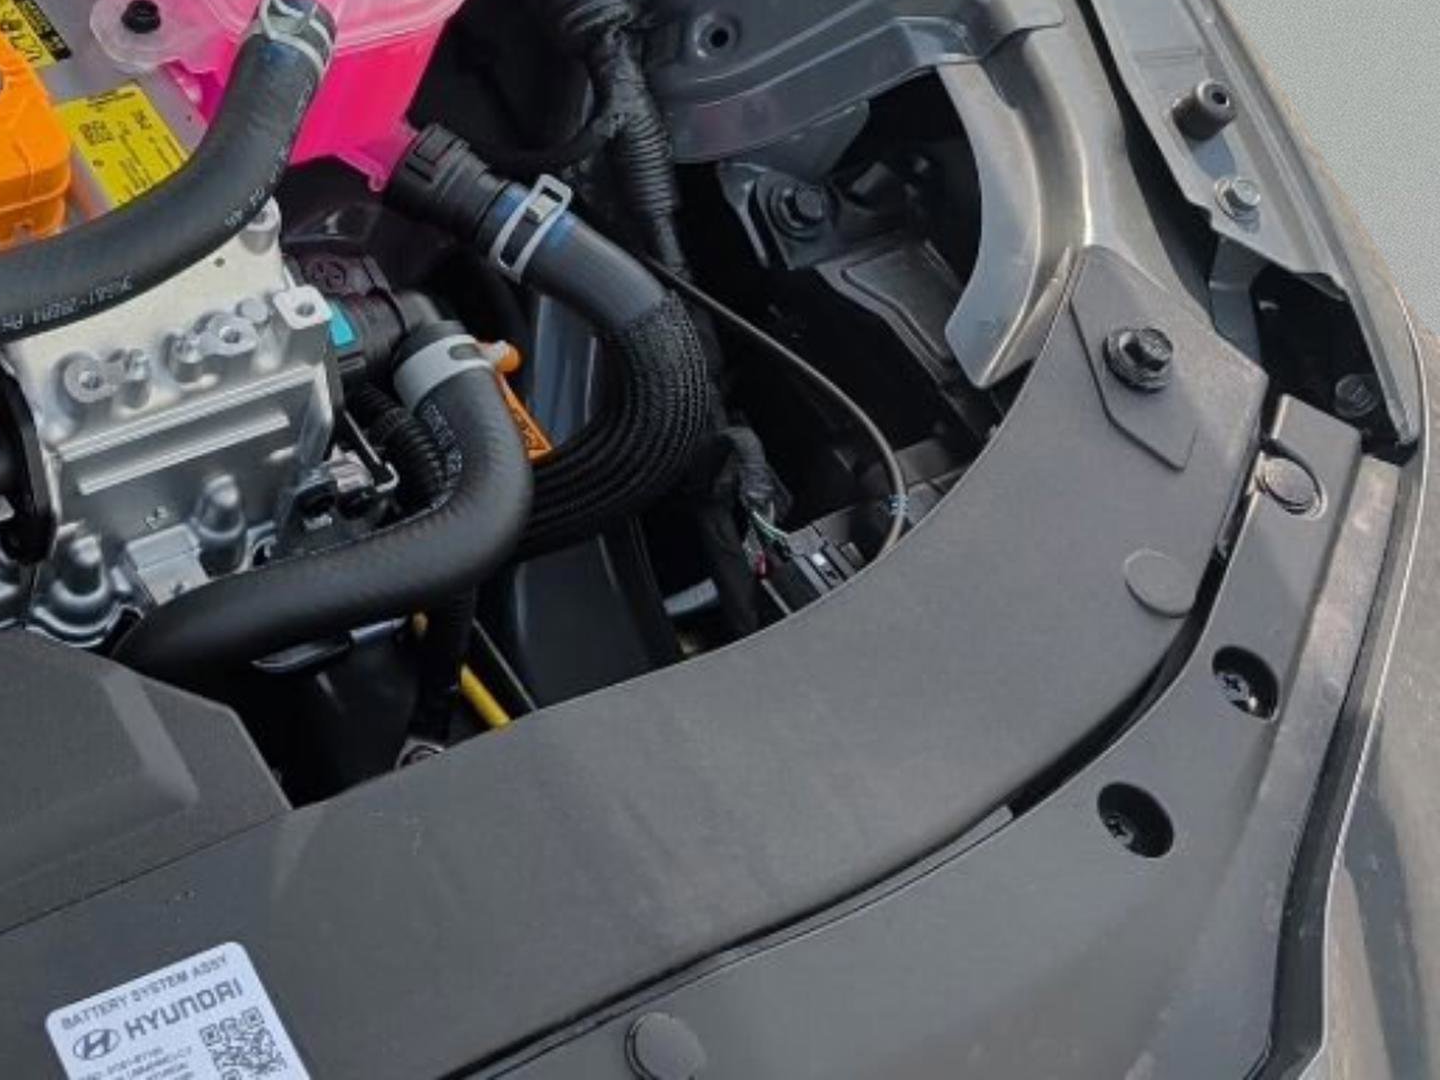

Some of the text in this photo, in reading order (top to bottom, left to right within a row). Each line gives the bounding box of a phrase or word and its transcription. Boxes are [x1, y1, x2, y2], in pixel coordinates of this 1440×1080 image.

[62, 953, 227, 1031] BATTERY SYSTEM ASSY
[123, 977, 244, 1041] HYUNDAI
